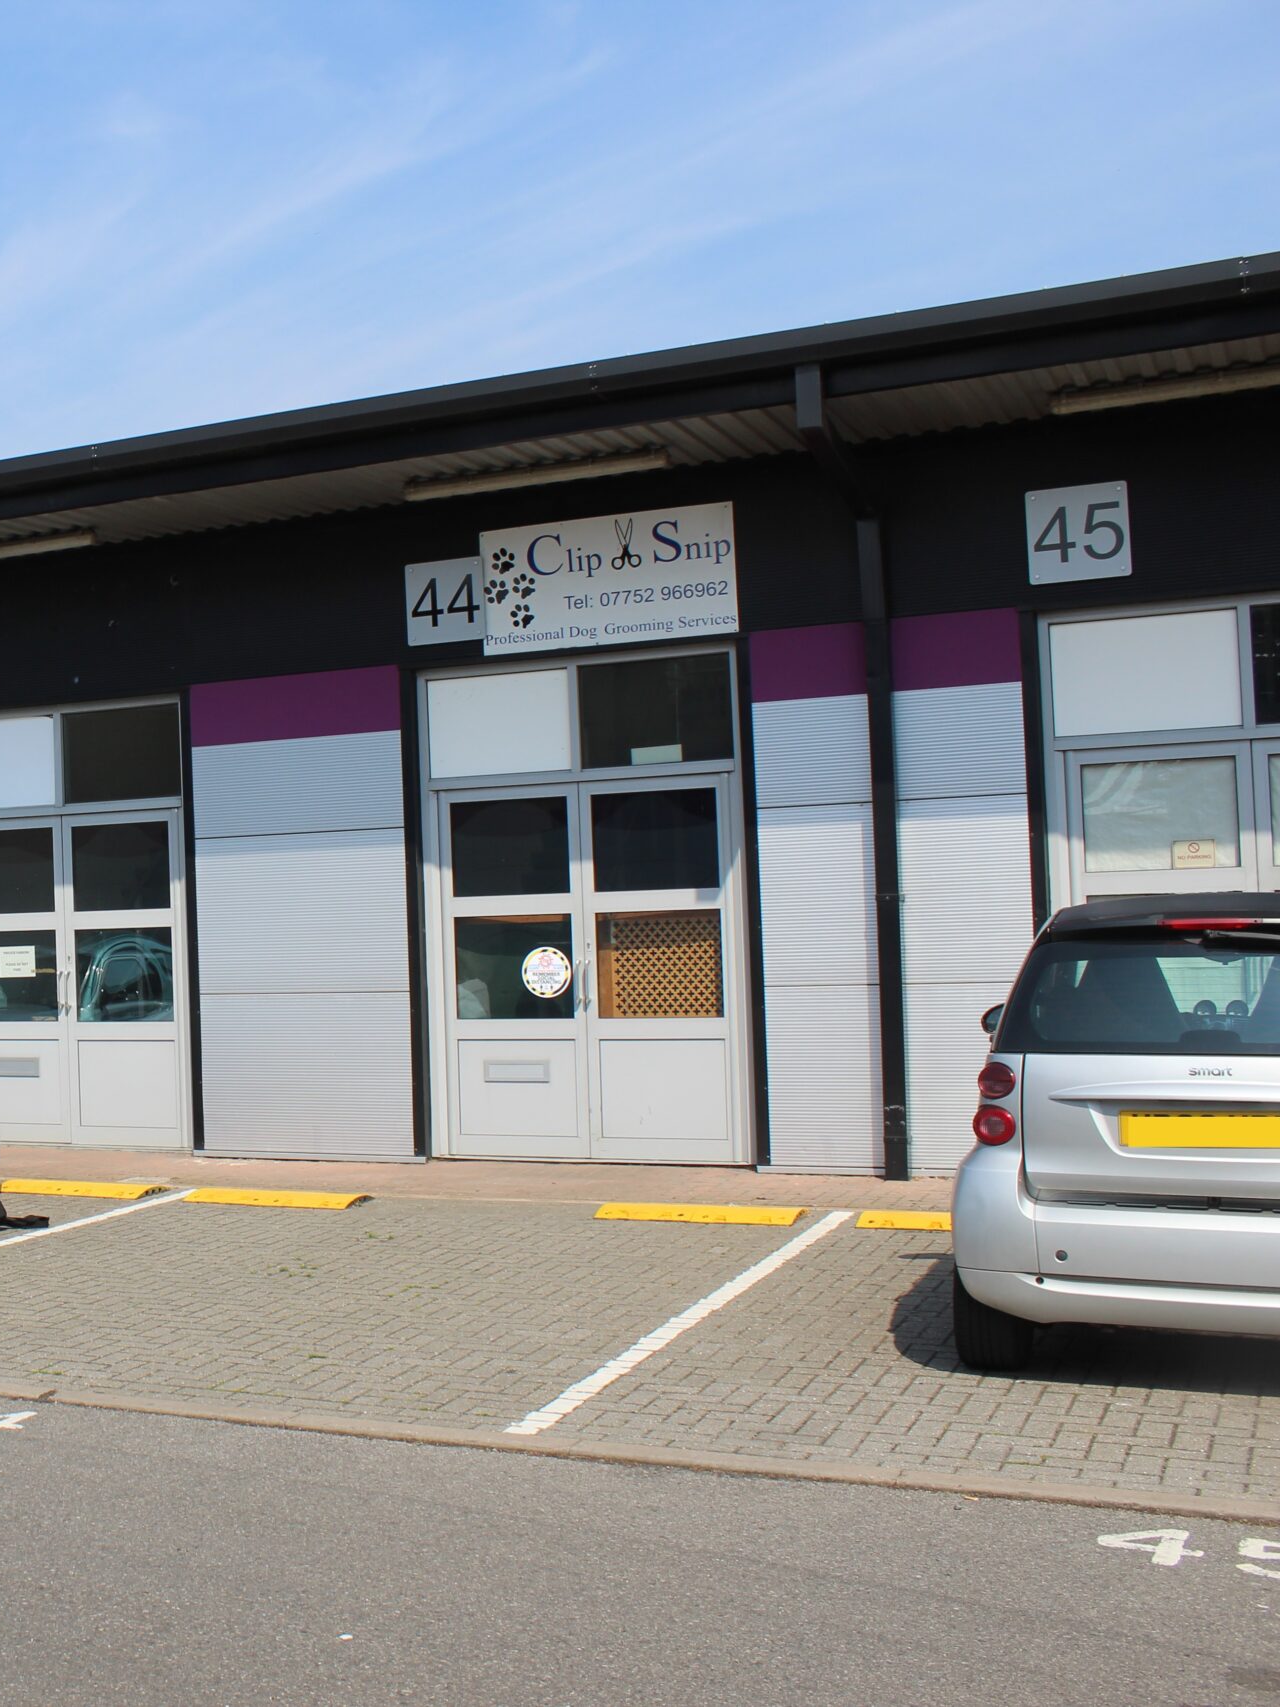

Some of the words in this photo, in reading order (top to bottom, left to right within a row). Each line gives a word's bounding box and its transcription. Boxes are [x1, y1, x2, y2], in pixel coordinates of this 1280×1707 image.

[526, 534, 602, 578] Clip
[651, 520, 732, 565] Snip
[1033, 501, 1125, 563] 45
[411, 573, 480, 627] 44
[563, 594, 594, 611] Tel:
[599, 588, 655, 608] 07752
[660, 580, 729, 601] 966962
[484, 626, 564, 647] Professional
[569, 624, 598, 640] Dog
[604, 617, 673, 636] Grooming
[677, 613, 737, 629] Services
[1189, 1067, 1232, 1077] smart
